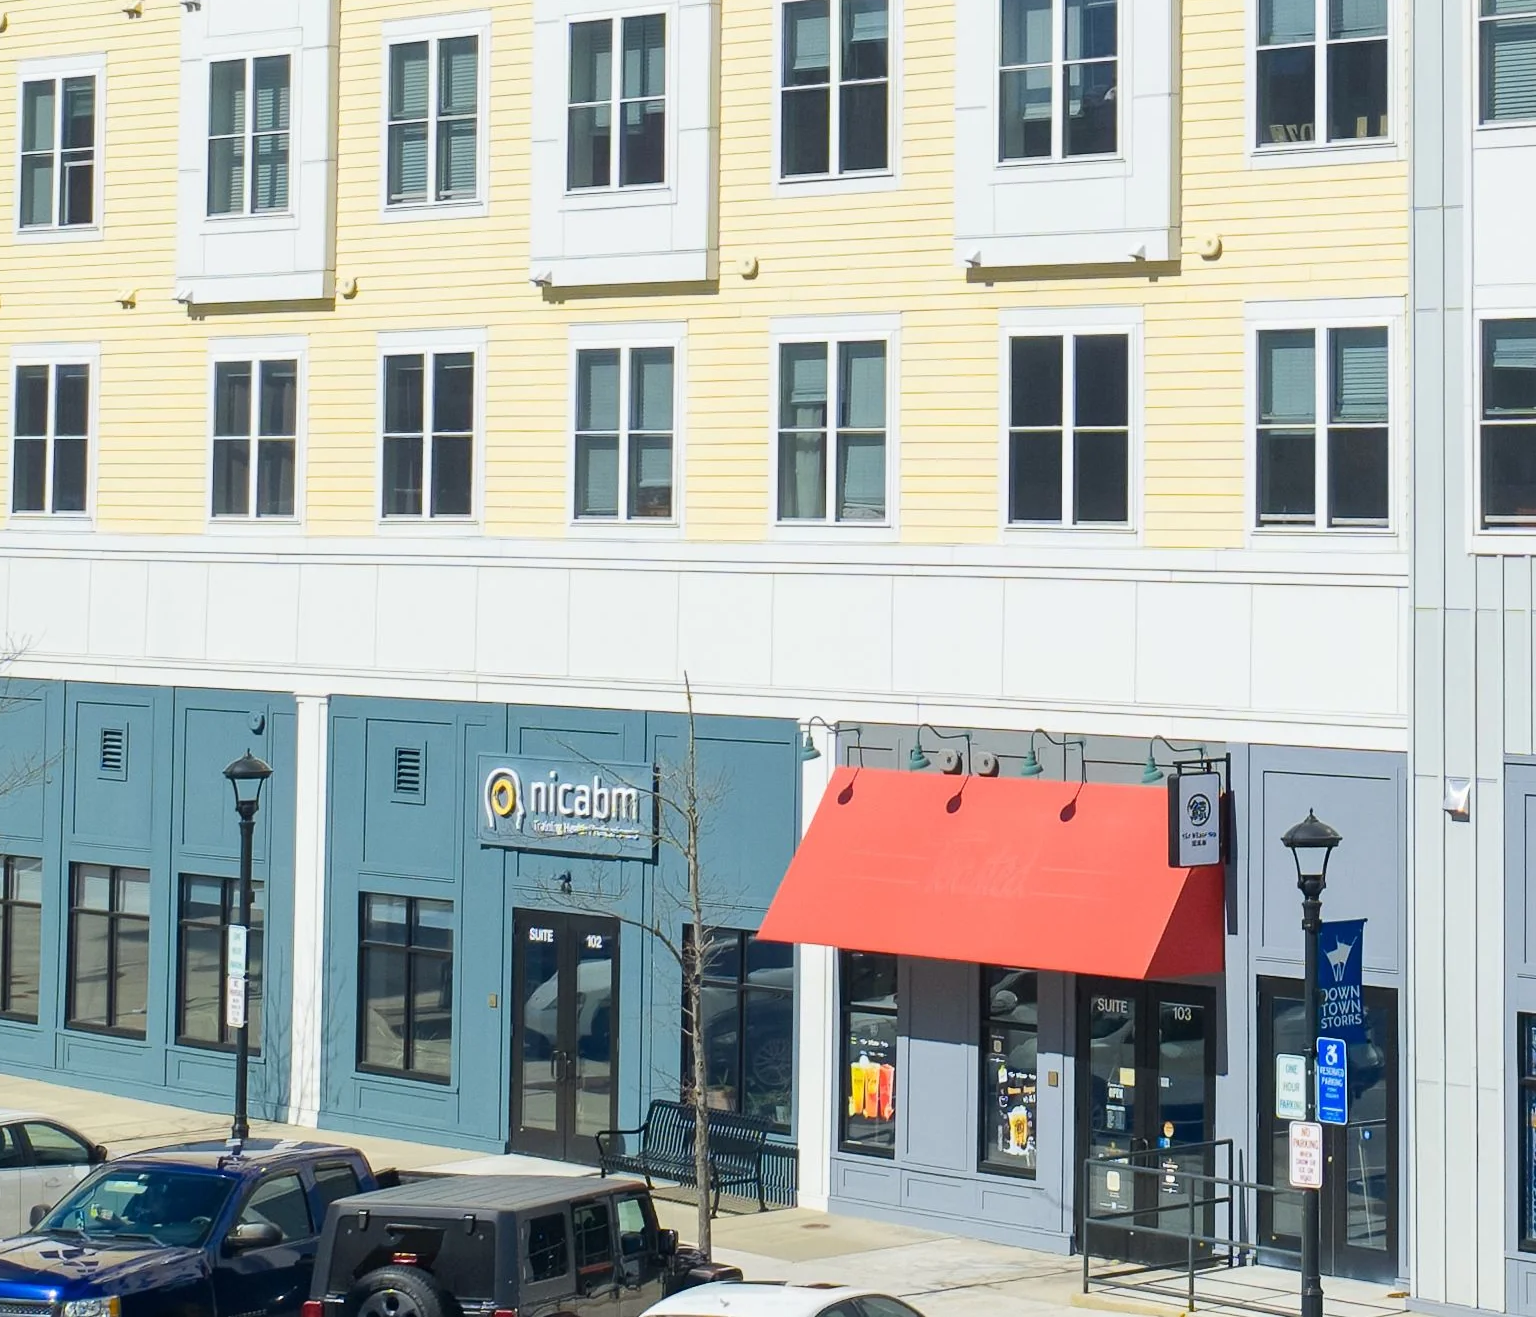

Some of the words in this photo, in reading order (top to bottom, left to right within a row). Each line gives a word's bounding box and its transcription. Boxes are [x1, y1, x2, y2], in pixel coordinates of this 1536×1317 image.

[530, 770, 638, 820] nicabm
[529, 928, 554, 943] SUITE
[585, 935, 603, 949] 102
[1097, 998, 1128, 1013] SUITE
[1321, 1000, 1362, 1017] TOWN
[1172, 1006, 1192, 1021] 103
[1321, 1013, 1363, 1029] STORRS
